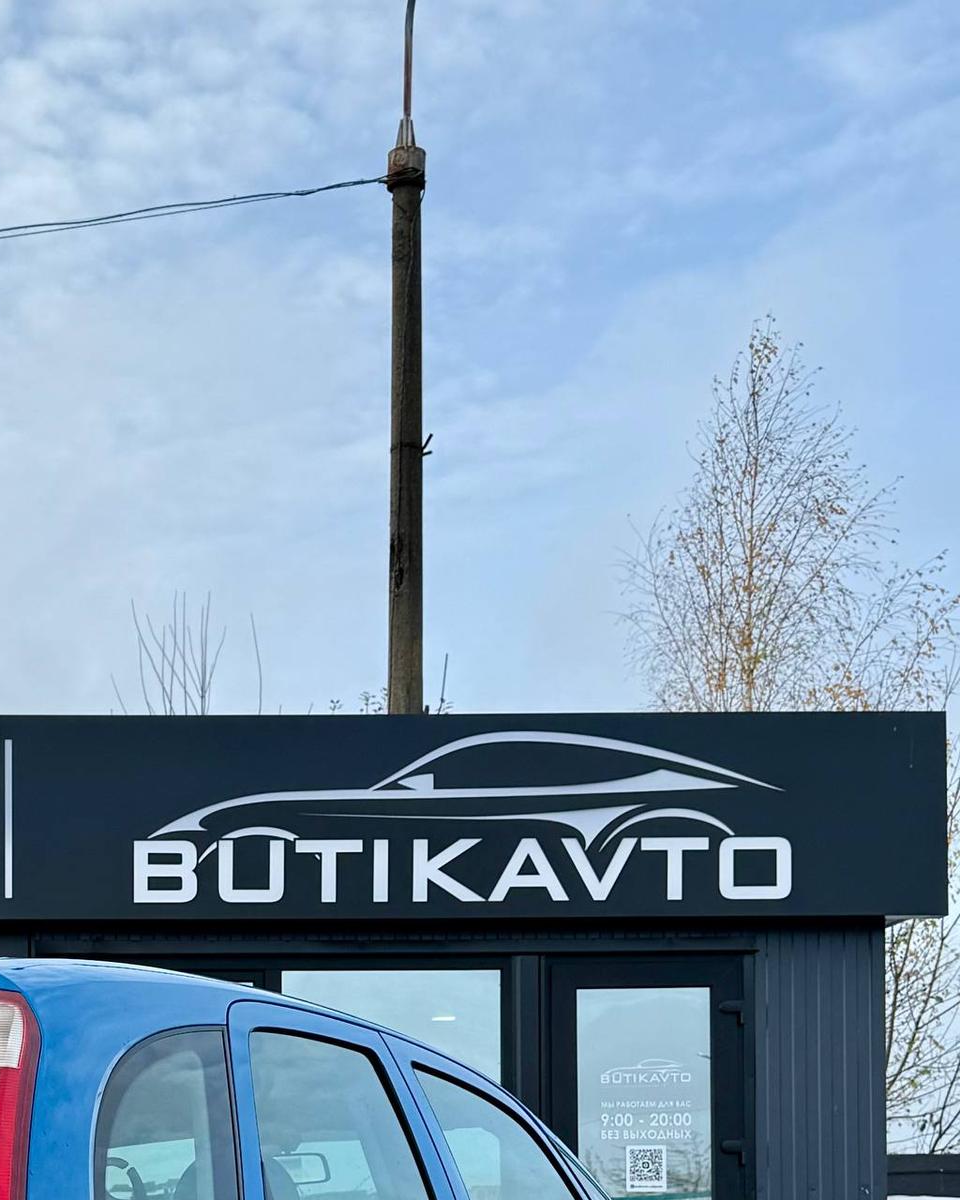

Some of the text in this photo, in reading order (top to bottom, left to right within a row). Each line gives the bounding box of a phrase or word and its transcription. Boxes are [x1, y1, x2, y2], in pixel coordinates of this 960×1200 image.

[133, 836, 792, 903] BUTIKAVTO
[600, 1072, 692, 1084] BUTIKAVTO
[601, 1113, 633, 1127] 9:00
[649, 1113, 692, 1127] 20:00
[601, 1129, 692, 1140] БЕЗ ВЫХОДНЫХ
